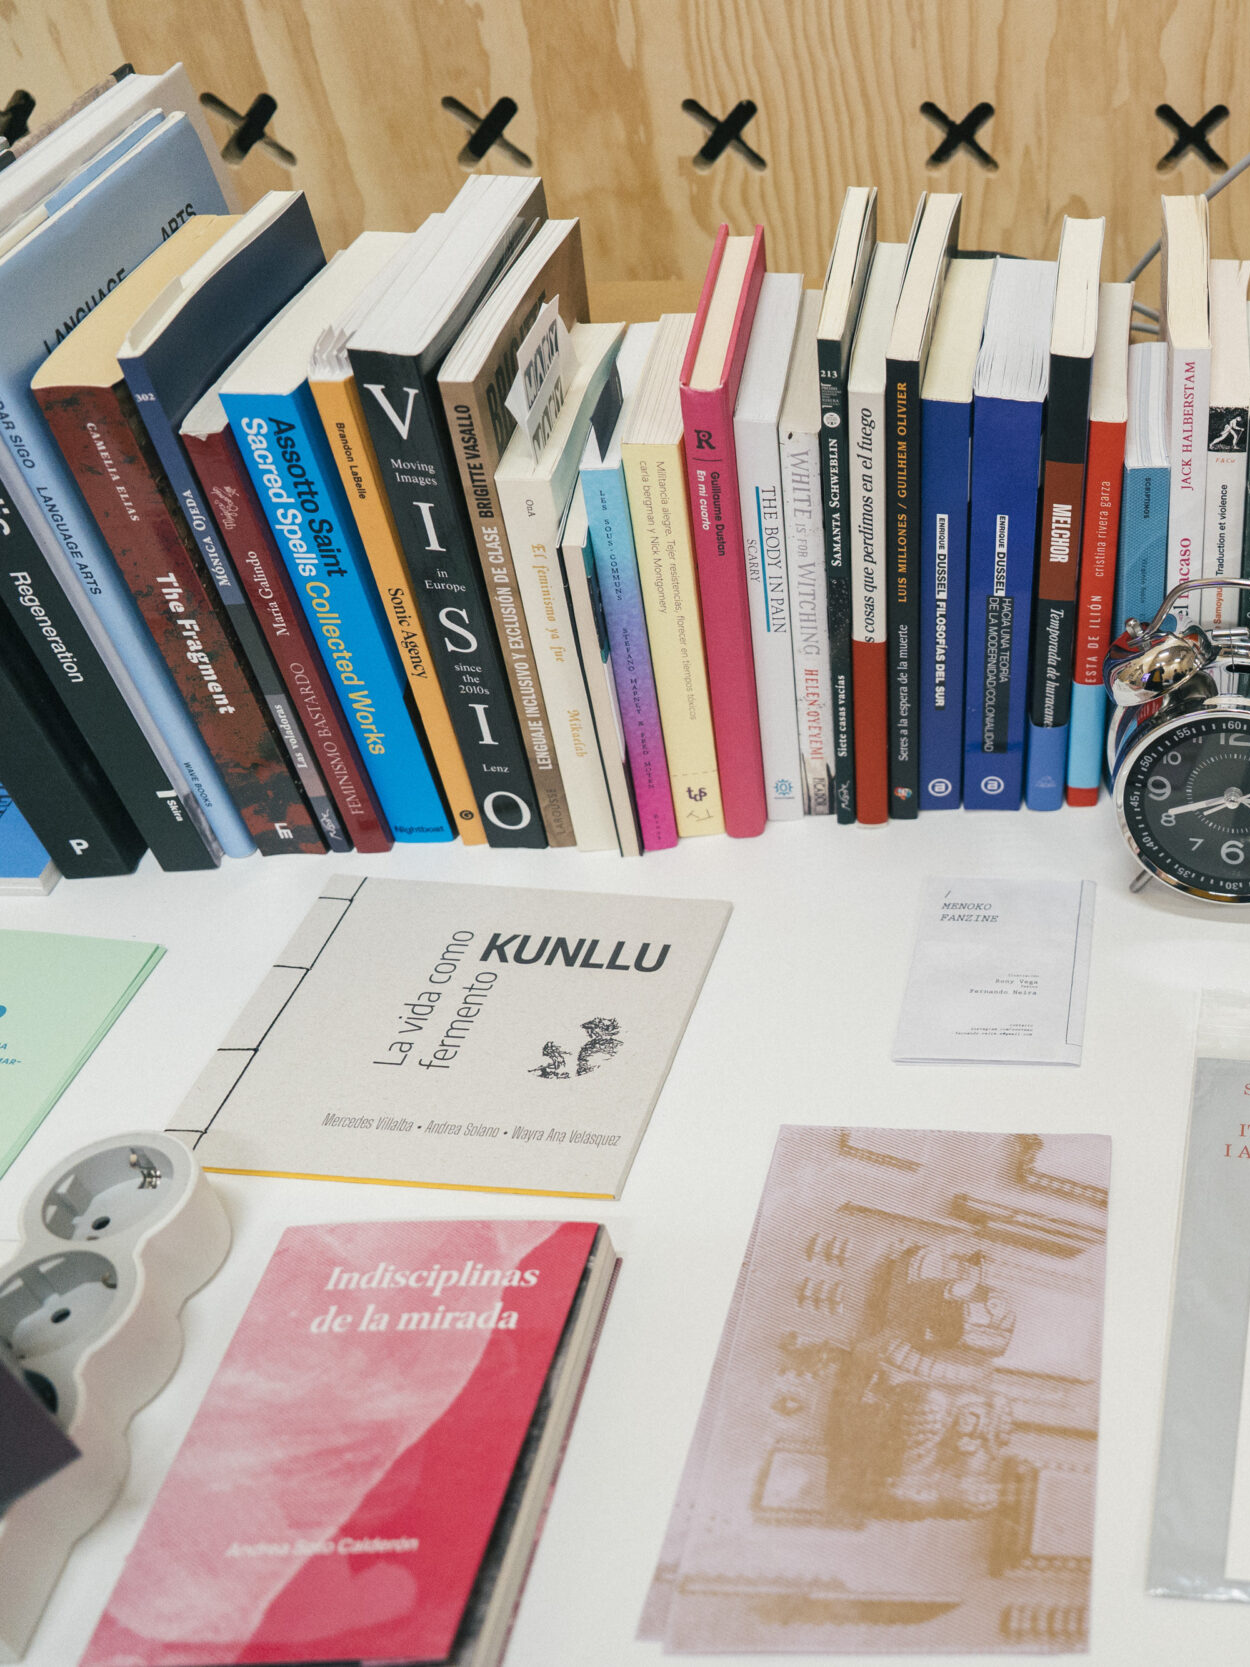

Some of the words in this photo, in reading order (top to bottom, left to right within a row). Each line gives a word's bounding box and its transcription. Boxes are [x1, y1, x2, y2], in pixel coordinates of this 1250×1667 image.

[820, 370, 838, 379] 213
[897, 382, 907, 436] OLIVIER
[1182, 361, 1196, 454] HALBERSTAM
[454, 404, 481, 464] VASALLO
[85, 421, 119, 483] CAMELIA
[115, 484, 140, 522] ELIAS
[335, 422, 354, 463] Brandon
[348, 463, 366, 500] LaBelle
[390, 458, 435, 474] Moving
[696, 470, 706, 482] En
[897, 441, 907, 498] GUILHEM
[1181, 458, 1194, 491] JACK
[396, 472, 437, 486] Images
[467, 462, 494, 519] BRIGITTE
[698, 483, 708, 496] mi
[268, 416, 320, 514] Assotto
[308, 516, 348, 578] Saint
[710, 471, 722, 521] Guillaume
[761, 486, 778, 520] THE
[699, 498, 710, 531] cuarto
[482, 525, 505, 564] CLASE
[715, 524, 725, 556] Dustan
[765, 526, 782, 573] BODY
[897, 513, 907, 573] MILLONES
[938, 517, 946, 550] ENRIQUE
[1049, 503, 1072, 563] MELCHOR
[242, 417, 296, 498] Sacred
[278, 507, 316, 577] Spells
[306, 581, 359, 684] Collected
[348, 681, 385, 755] Works
[424, 580, 467, 592] Europe
[437, 568, 448, 578] in
[491, 567, 510, 584] DE
[768, 575, 783, 593] IN
[936, 553, 947, 596] DUSSEL
[897, 578, 907, 603] LUIS
[9, 571, 84, 683] Regeneration
[500, 589, 524, 650] EXCLUSIÓN
[771, 597, 787, 633] PAIN
[935, 601, 946, 661] FILOSOFÍAS
[156, 573, 185, 613] The
[177, 619, 235, 715] Fragment
[388, 587, 412, 627] Sonic
[400, 627, 428, 680] Agency
[454, 663, 482, 673] since
[512, 653, 527, 665] Y
[935, 663, 945, 680] DEL
[459, 685, 490, 695] 2010s
[462, 673, 480, 684] the
[516, 667, 541, 717] INCLUSIVO
[935, 683, 945, 707] SUR
[1178, 728, 1190, 738] 55
[1228, 721, 1241, 730] 60
[528, 720, 553, 770] LENGUAJE
[482, 763, 510, 774] Lenz
[1129, 795, 1139, 807] 45
[1147, 775, 1171, 801] 9
[1189, 838, 1203, 851] 7
[1221, 840, 1244, 865] 6
[940, 914, 999, 923] FANZINE
[942, 903, 992, 911] MENOKO
[480, 932, 671, 973] KUNLLU
[373, 1040, 413, 1067] La
[398, 992, 442, 1036] vida
[429, 931, 474, 984] como
[419, 971, 498, 1070] fermento
[321, 1113, 375, 1130] Mercedes
[376, 1115, 414, 1133] Villalba
[424, 1120, 464, 1136] Andrea
[463, 1122, 500, 1138] Solano
[510, 1126, 545, 1142] Wayra
[545, 1129, 567, 1144] Ana
[569, 1129, 621, 1147] Velásquez
[1224, 1144, 1232, 1157] I
[324, 1261, 540, 1296] Indisciplinas
[309, 1306, 352, 1333] de
[358, 1304, 390, 1332] la
[396, 1302, 519, 1331] mirada
